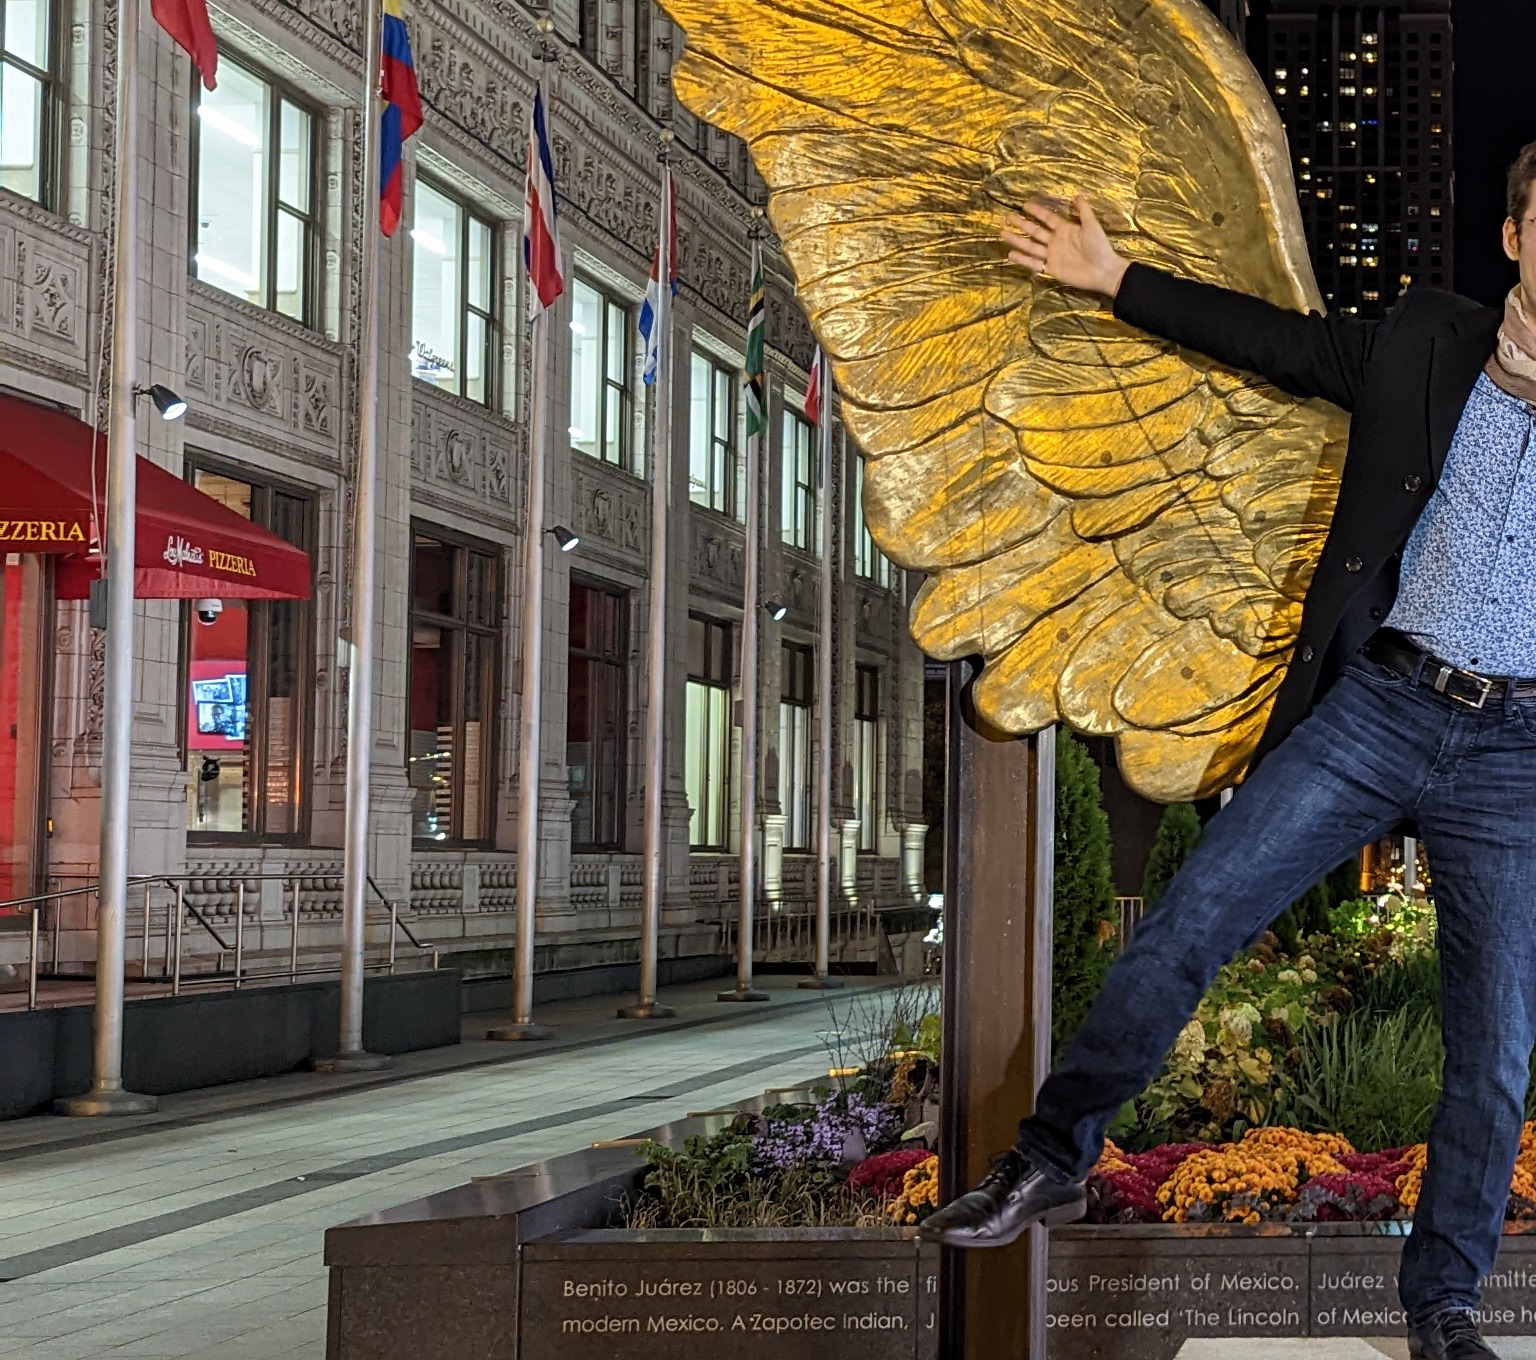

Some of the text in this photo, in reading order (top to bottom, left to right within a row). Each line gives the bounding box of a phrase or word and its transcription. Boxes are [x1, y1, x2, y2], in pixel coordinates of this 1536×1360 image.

[0, 521, 86, 541] ZZERIA
[208, 549, 257, 577] PIZZERIA
[563, 1279, 628, 1297] Benito
[635, 1277, 703, 1296] Juárez
[709, 1279, 758, 1299] (1806
[777, 1278, 823, 1298] 1872)
[828, 1279, 870, 1295] was
[876, 1276, 910, 1294] the
[1089, 1273, 1181, 1292] President
[1190, 1272, 1212, 1291] of
[1220, 1272, 1300, 1291] Mexico.
[1317, 1271, 1385, 1289] Juárez
[562, 1314, 640, 1333] modern
[646, 1313, 725, 1333] Mexico.
[730, 1314, 747, 1332] A
[751, 1313, 836, 1334] Zapotec
[843, 1311, 909, 1331] Indian,
[1104, 1309, 1170, 1327] called
[1228, 1307, 1300, 1327] Lincoln
[1316, 1307, 1338, 1326] of
[1472, 1308, 1516, 1324] ause
